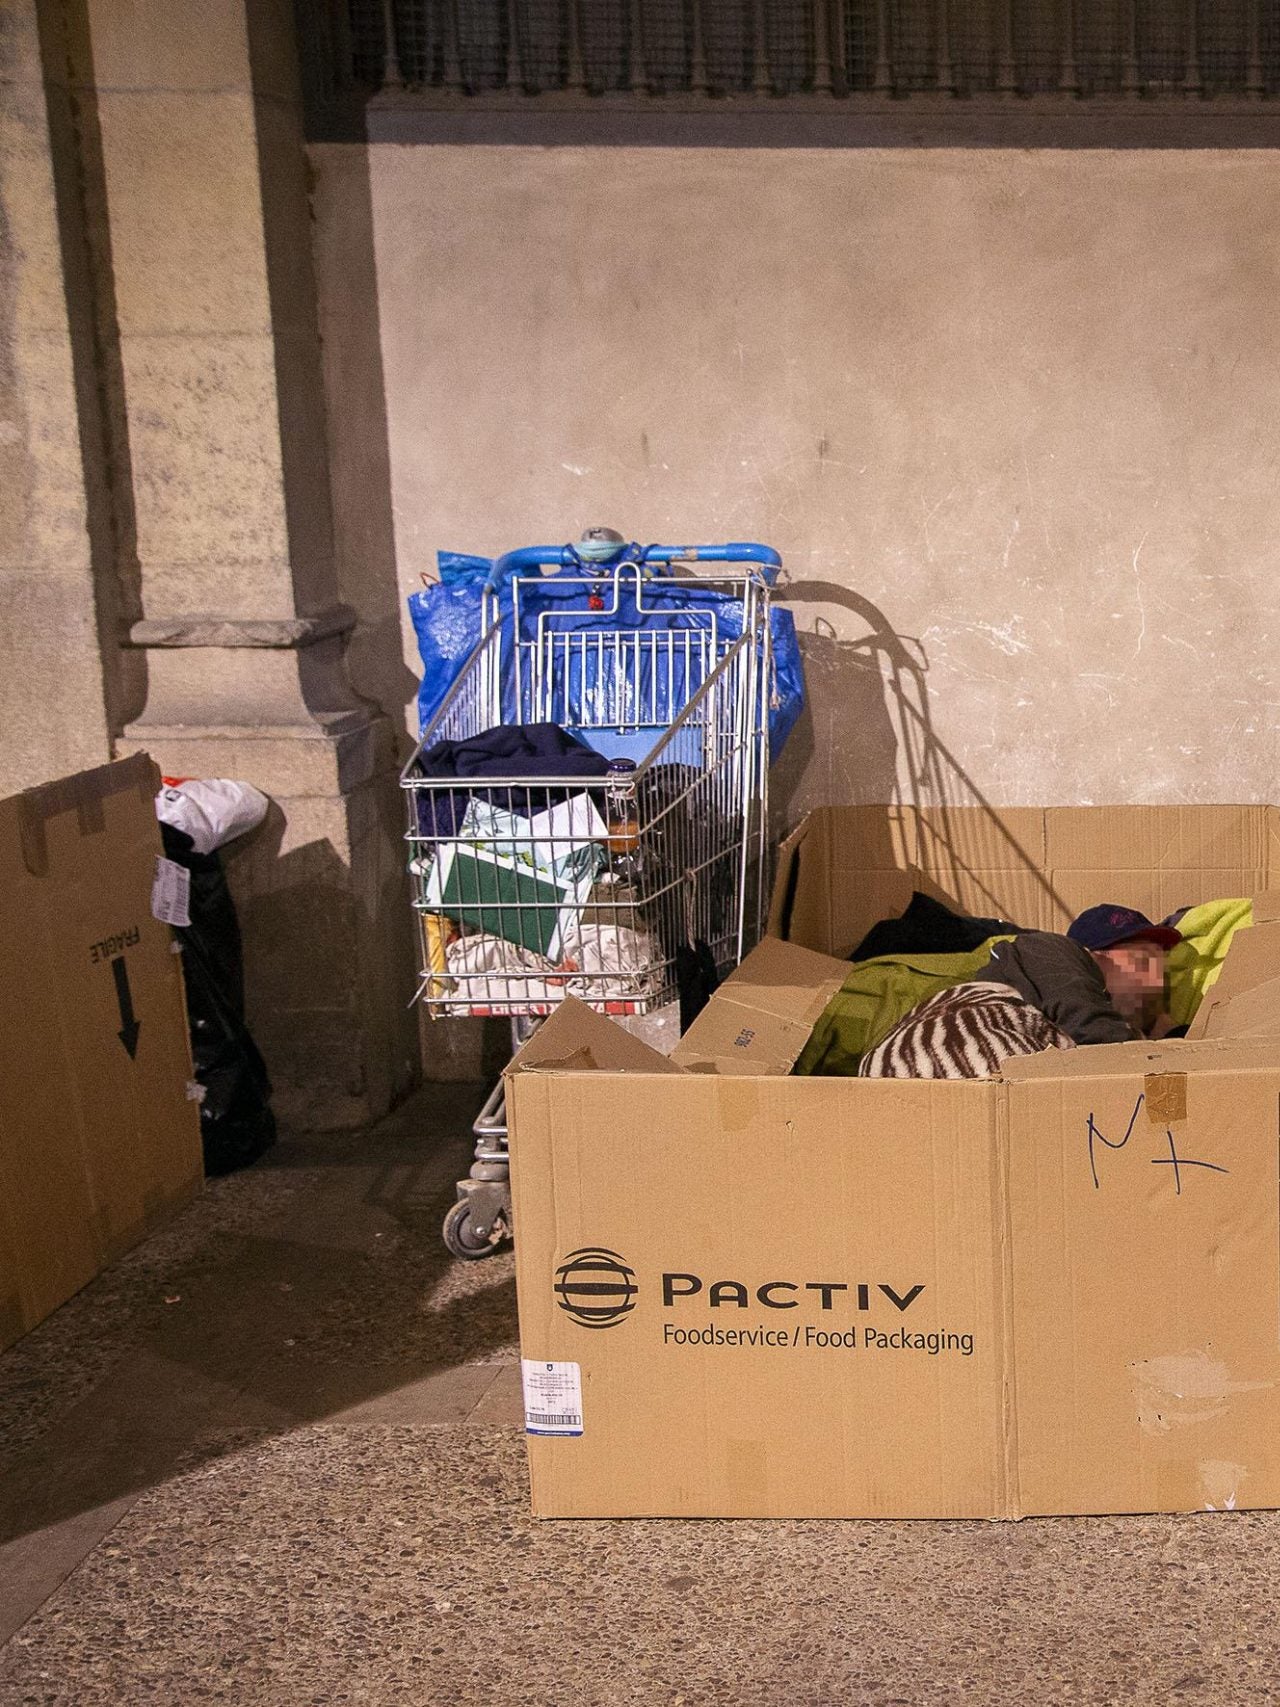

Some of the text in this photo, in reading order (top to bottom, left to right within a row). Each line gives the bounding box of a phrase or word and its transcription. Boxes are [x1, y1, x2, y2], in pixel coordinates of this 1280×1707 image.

[90, 925, 140, 964] FRAGILE
[663, 1323, 789, 1347] Foodservice
[805, 1326, 857, 1349] Food
[864, 1327, 974, 1356] Packaging
